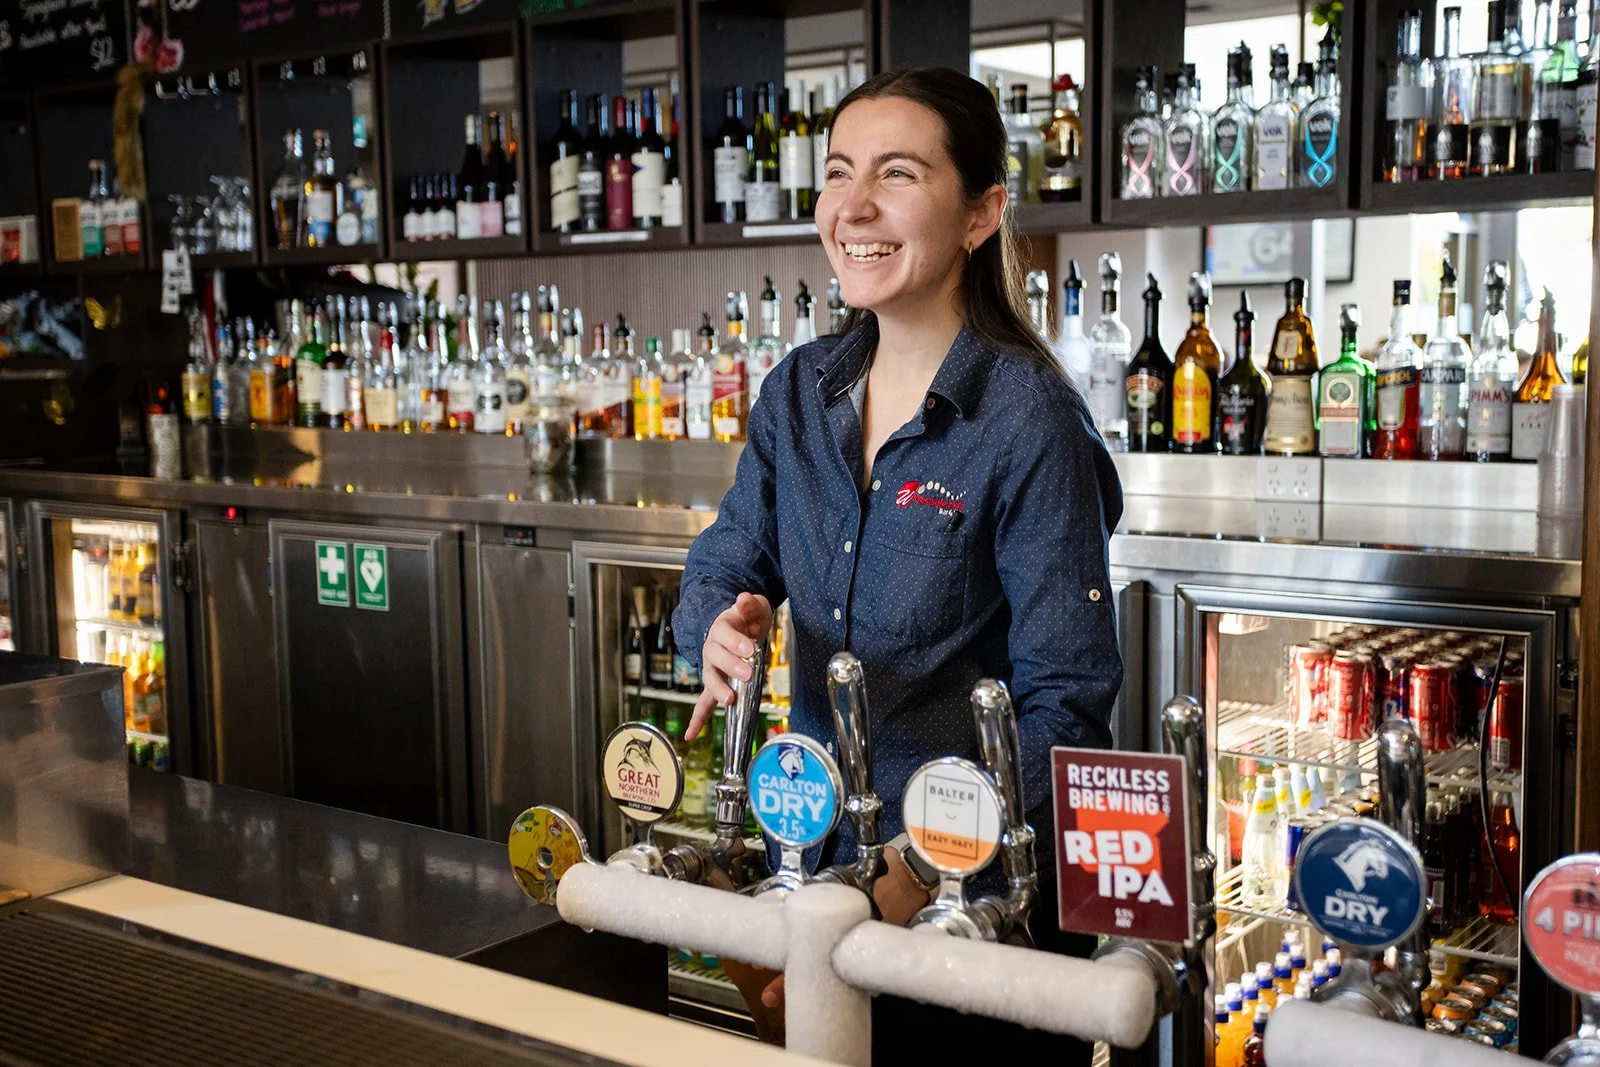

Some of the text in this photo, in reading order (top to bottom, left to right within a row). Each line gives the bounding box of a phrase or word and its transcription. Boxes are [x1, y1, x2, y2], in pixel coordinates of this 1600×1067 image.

[617, 767, 661, 788] GREAT
[618, 782, 660, 798] NORTHERN
[758, 773, 827, 798] CARLTON
[1067, 763, 1171, 793] RECKLESS
[758, 787, 826, 823] DRY
[929, 784, 975, 802] BALTER
[1068, 788, 1161, 817] BREWING
[1064, 830, 1154, 865] RED
[1098, 863, 1175, 907] IPA
[1335, 888, 1379, 904] CARLTON
[1324, 895, 1389, 926] DRY
[1534, 905, 1554, 932] 4
